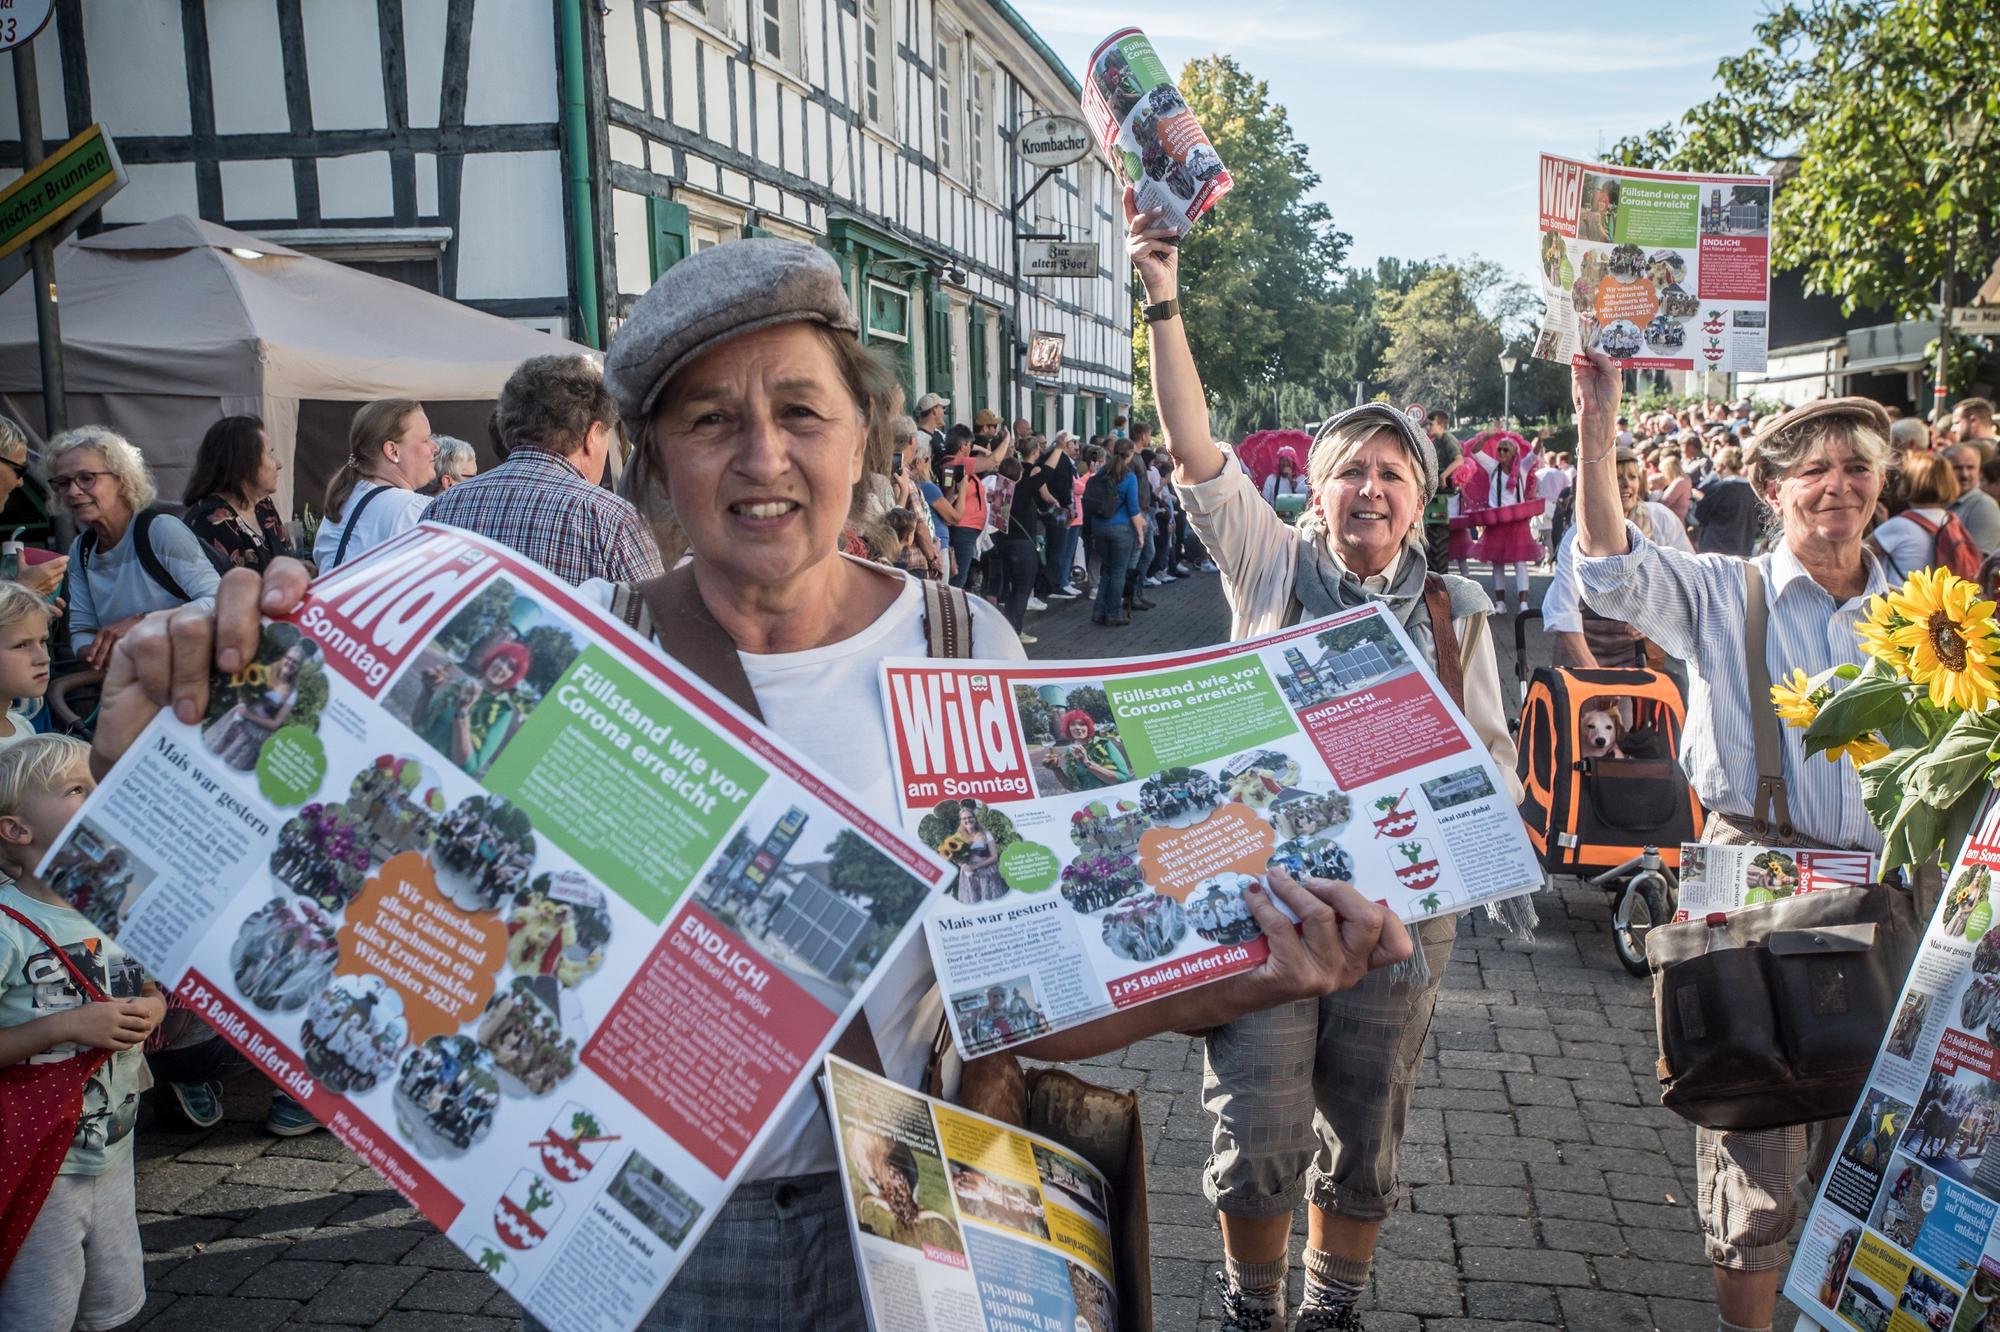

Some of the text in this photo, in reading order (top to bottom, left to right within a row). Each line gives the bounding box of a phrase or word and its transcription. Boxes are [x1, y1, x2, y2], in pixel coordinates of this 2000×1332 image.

[1022, 135, 1086, 155] Krombacher
[45, 150, 106, 203] Brunnen
[1542, 158, 1582, 221] Wild
[1621, 187, 1698, 202] Füllstand wie vor
[1620, 196, 1691, 210] Corona erreicht
[1540, 217, 1576, 235] am Sonntag
[1702, 239, 1741, 247] ENDLICH!
[1031, 258, 1088, 271] alten Post
[1048, 246, 1070, 258] Zur
[300, 604, 391, 687] Sonntag
[1112, 664, 1262, 705] Füllstand wie vor
[1117, 680, 1256, 719] Corona erreicht
[892, 672, 1019, 775] Wild
[1305, 692, 1376, 723] ENDLICH!
[1310, 697, 1393, 730] Das Rätsel ist gelöst
[556, 683, 633, 750] Corona
[631, 743, 719, 816] erreicht
[570, 662, 748, 805] Füllstand wie vor
[153, 735, 270, 838] Mais war gestern
[907, 776, 1028, 798] am Sonntag
[1156, 814, 1233, 852] Wir wünschen
[1437, 804, 1492, 825] Lokal statt global
[1156, 817, 1245, 865] allen Gästen und
[1159, 830, 1266, 886] tolles Erntedankfest
[1164, 826, 1249, 872] Teilnehmern ein
[1965, 848, 1979, 859] am
[1171, 841, 1265, 889] Witzhelden 2023!
[1801, 853, 1810, 870] am
[378, 895, 487, 965] allen Gästen und
[397, 879, 487, 944] Wir wünschen
[937, 900, 1059, 932] Mais war gestern
[353, 920, 478, 1005] tolles Erntedankfest
[375, 910, 475, 981] Teilnehmern ein
[679, 915, 770, 992] ENDLICH!
[1930, 939, 1942, 950] Mais
[1952, 947, 1972, 959] gestern
[353, 940, 462, 1017] Witzhelden 2023!
[669, 932, 772, 1019] Das Rätsel ist gelöst
[1111, 945, 1249, 998] 2 PS Bolide liefert sich
[179, 978, 315, 1099] 2 PS Bolide liefert sich
[1946, 1033, 1953, 1044] PS
[1952, 1035, 1969, 1050] Bolide
[1967, 1041, 1985, 1056] liefert
[1983, 1047, 1994, 1060] sich
[332, 1110, 353, 1130] Wie
[350, 1124, 378, 1150] durch
[385, 1155, 418, 1191] Wunder
[1839, 1155, 1879, 1183] Neuer Laborunfall
[1943, 1185, 1996, 1219] Amphorenfeld
[1944, 1201, 1989, 1233] auf Baustelle
[593, 1201, 655, 1258] Lokal statt global
[1954, 1222, 1985, 1246] entdeckt
[926, 1248, 966, 1268] FITBOOK
[979, 1281, 1035, 1307] entdeckt
[984, 1299, 1043, 1329] Baustelle
